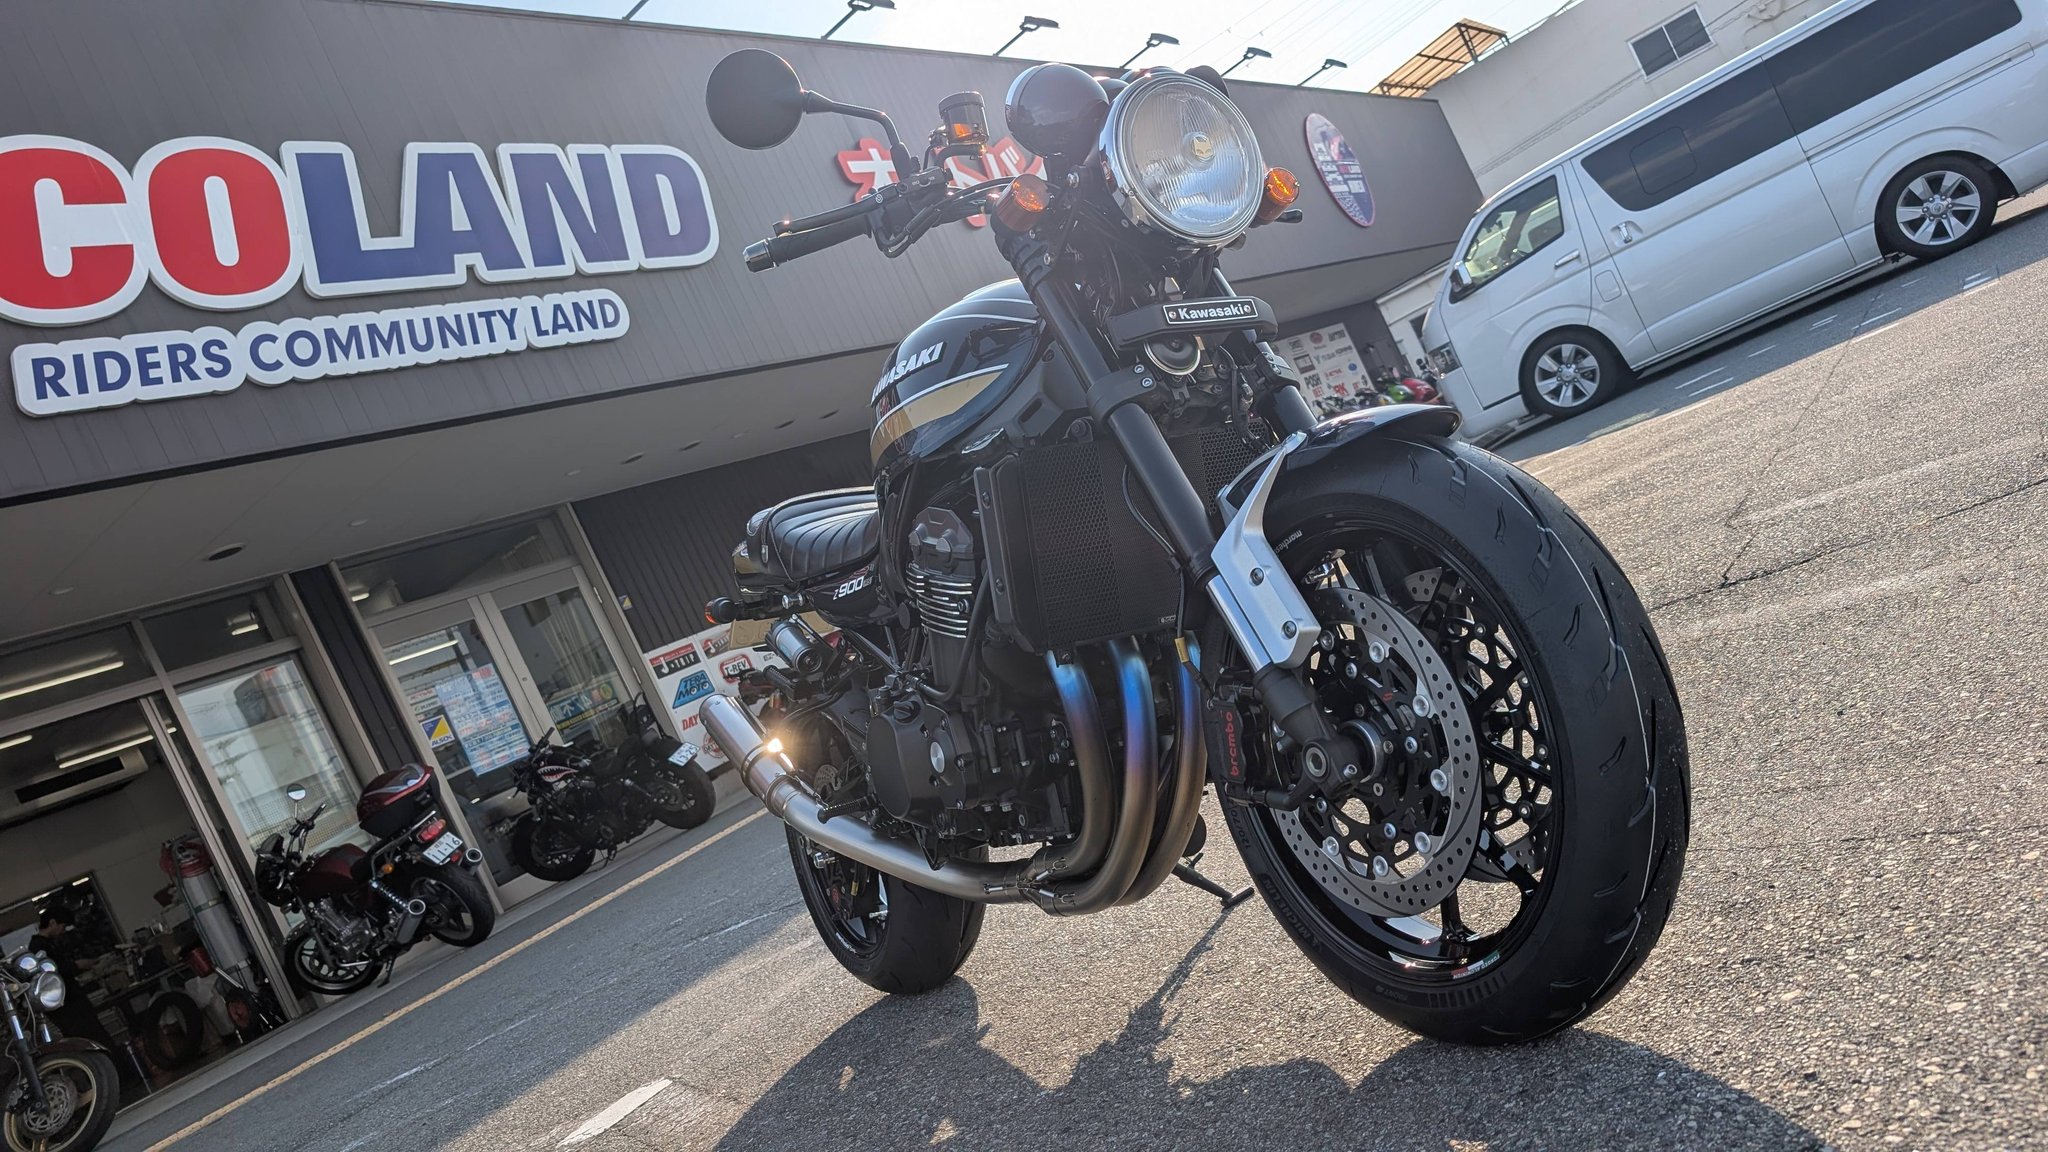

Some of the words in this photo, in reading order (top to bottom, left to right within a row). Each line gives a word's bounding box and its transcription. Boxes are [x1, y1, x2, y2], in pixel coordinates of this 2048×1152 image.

[1178, 303, 1244, 320] Kawasaki
[30, 338, 232, 400] RIDERS
[249, 307, 525, 373] COMMUNITY
[530, 297, 621, 338] LAND
[677, 680, 711, 700] MOTO
[684, 673, 707, 688] TERA
[1225, 711, 1240, 776] brembo
[431, 837, 460, 862] 11-16
[1263, 878, 1312, 939] MICHELIN
